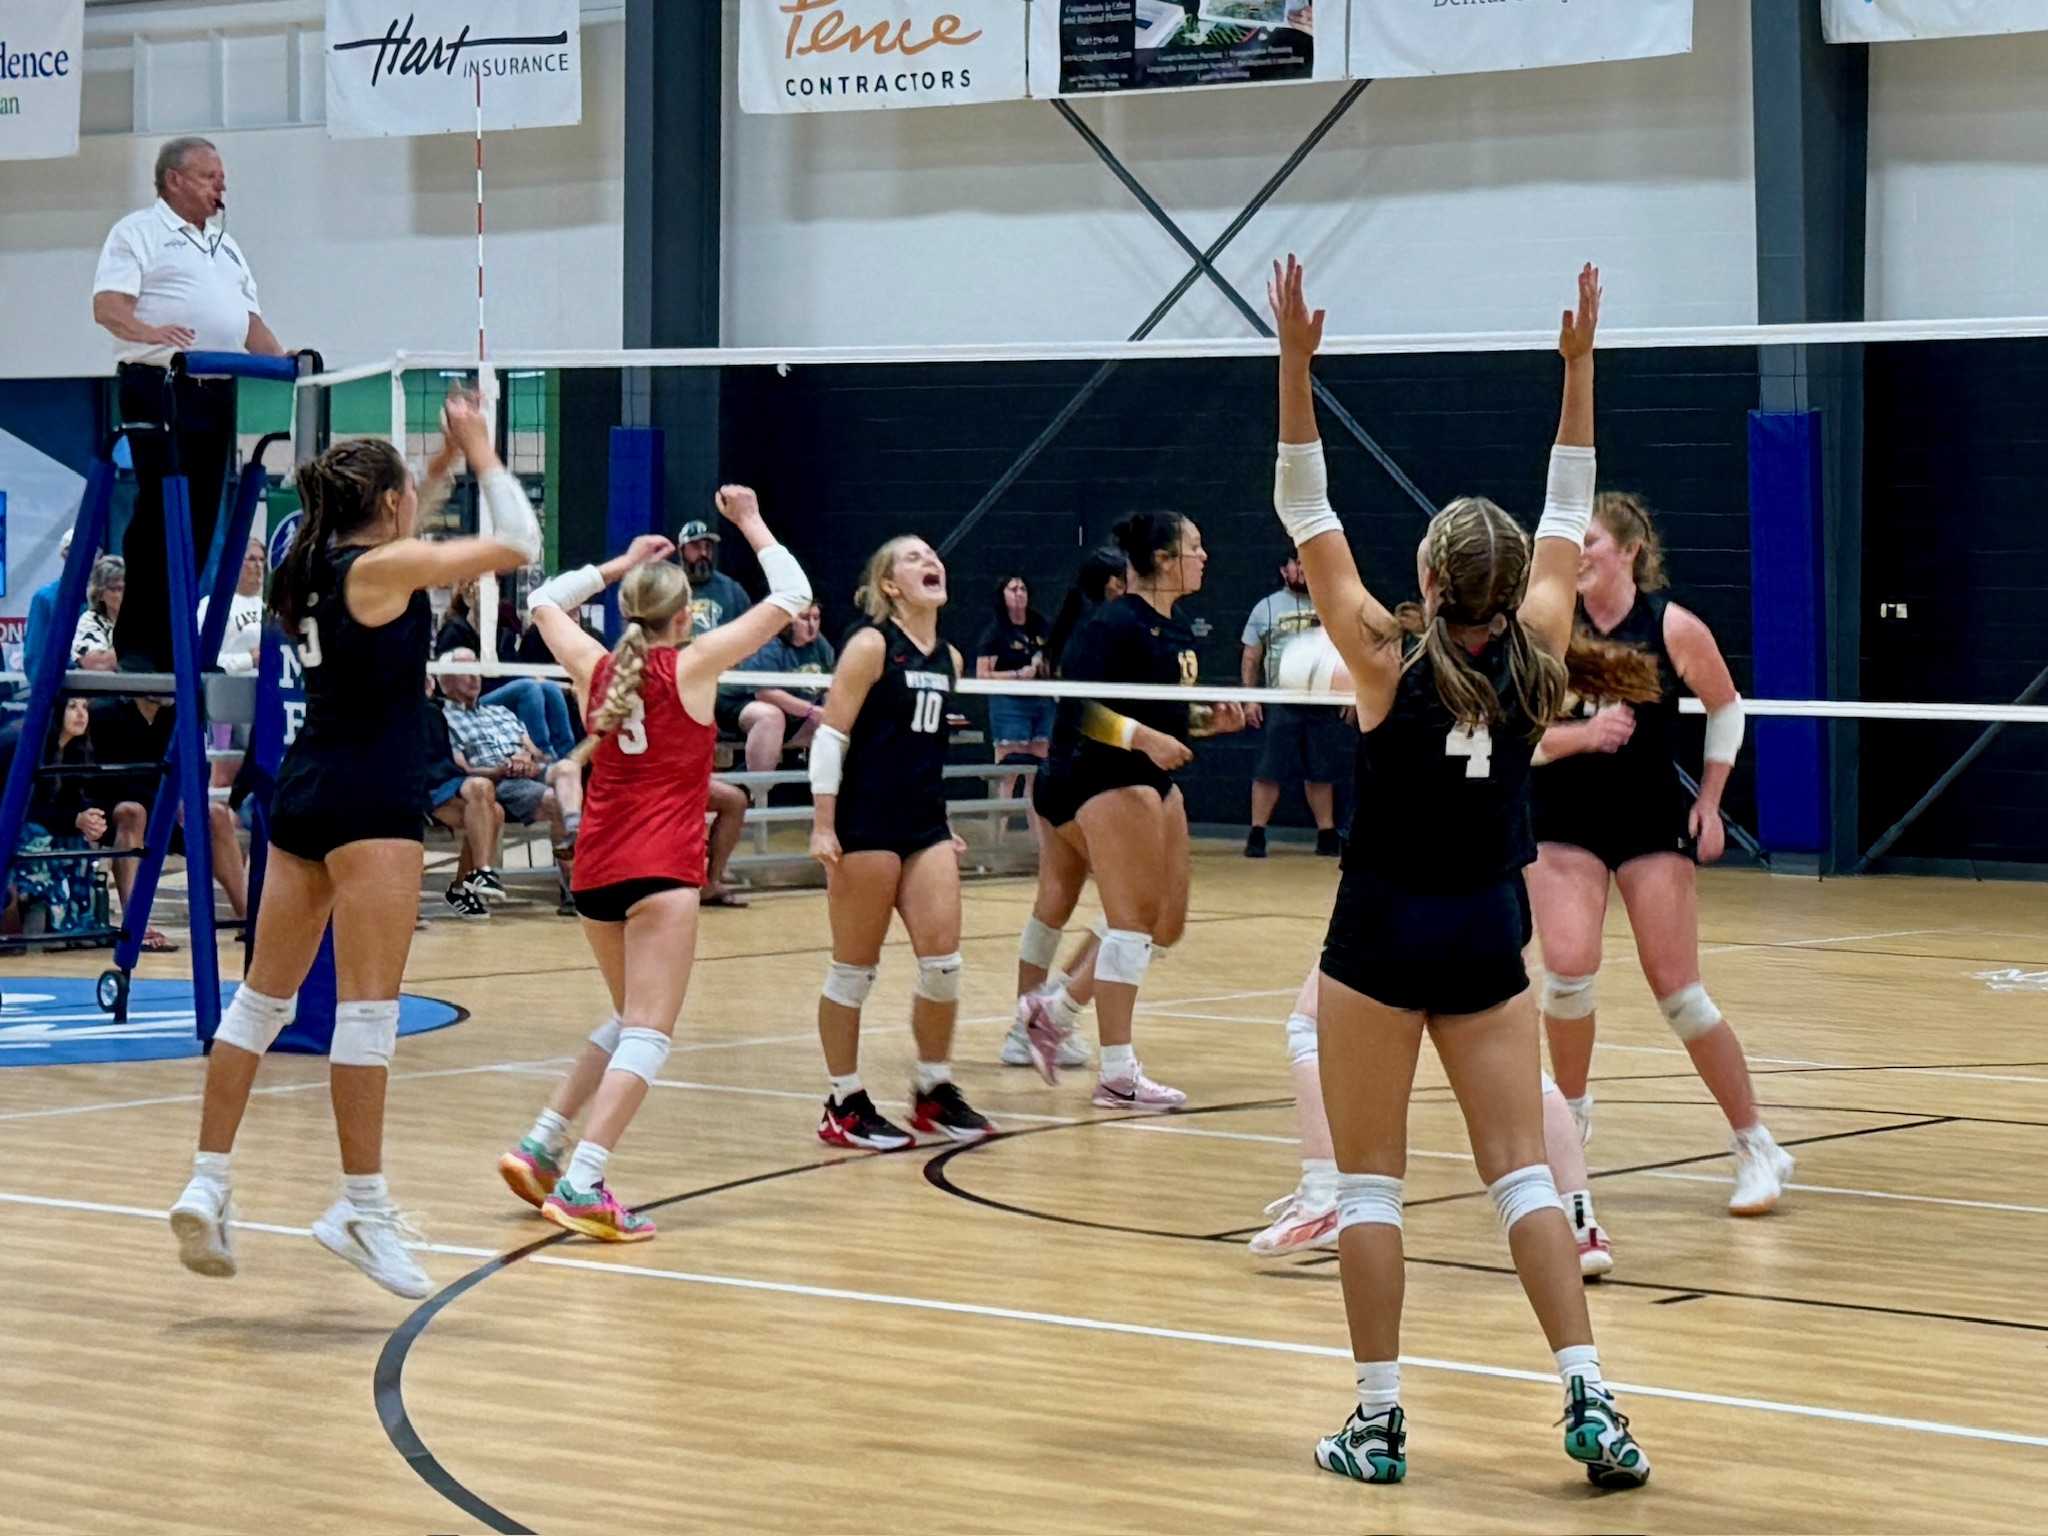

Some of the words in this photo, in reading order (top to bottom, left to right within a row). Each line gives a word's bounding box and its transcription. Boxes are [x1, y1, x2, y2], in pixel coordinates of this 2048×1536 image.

[463, 53, 568, 78] INSURANCE
[785, 69, 971, 96] CONTRACTORS
[617, 689, 649, 755] 3
[911, 690, 943, 733] 10
[1445, 719, 1493, 778] 4
